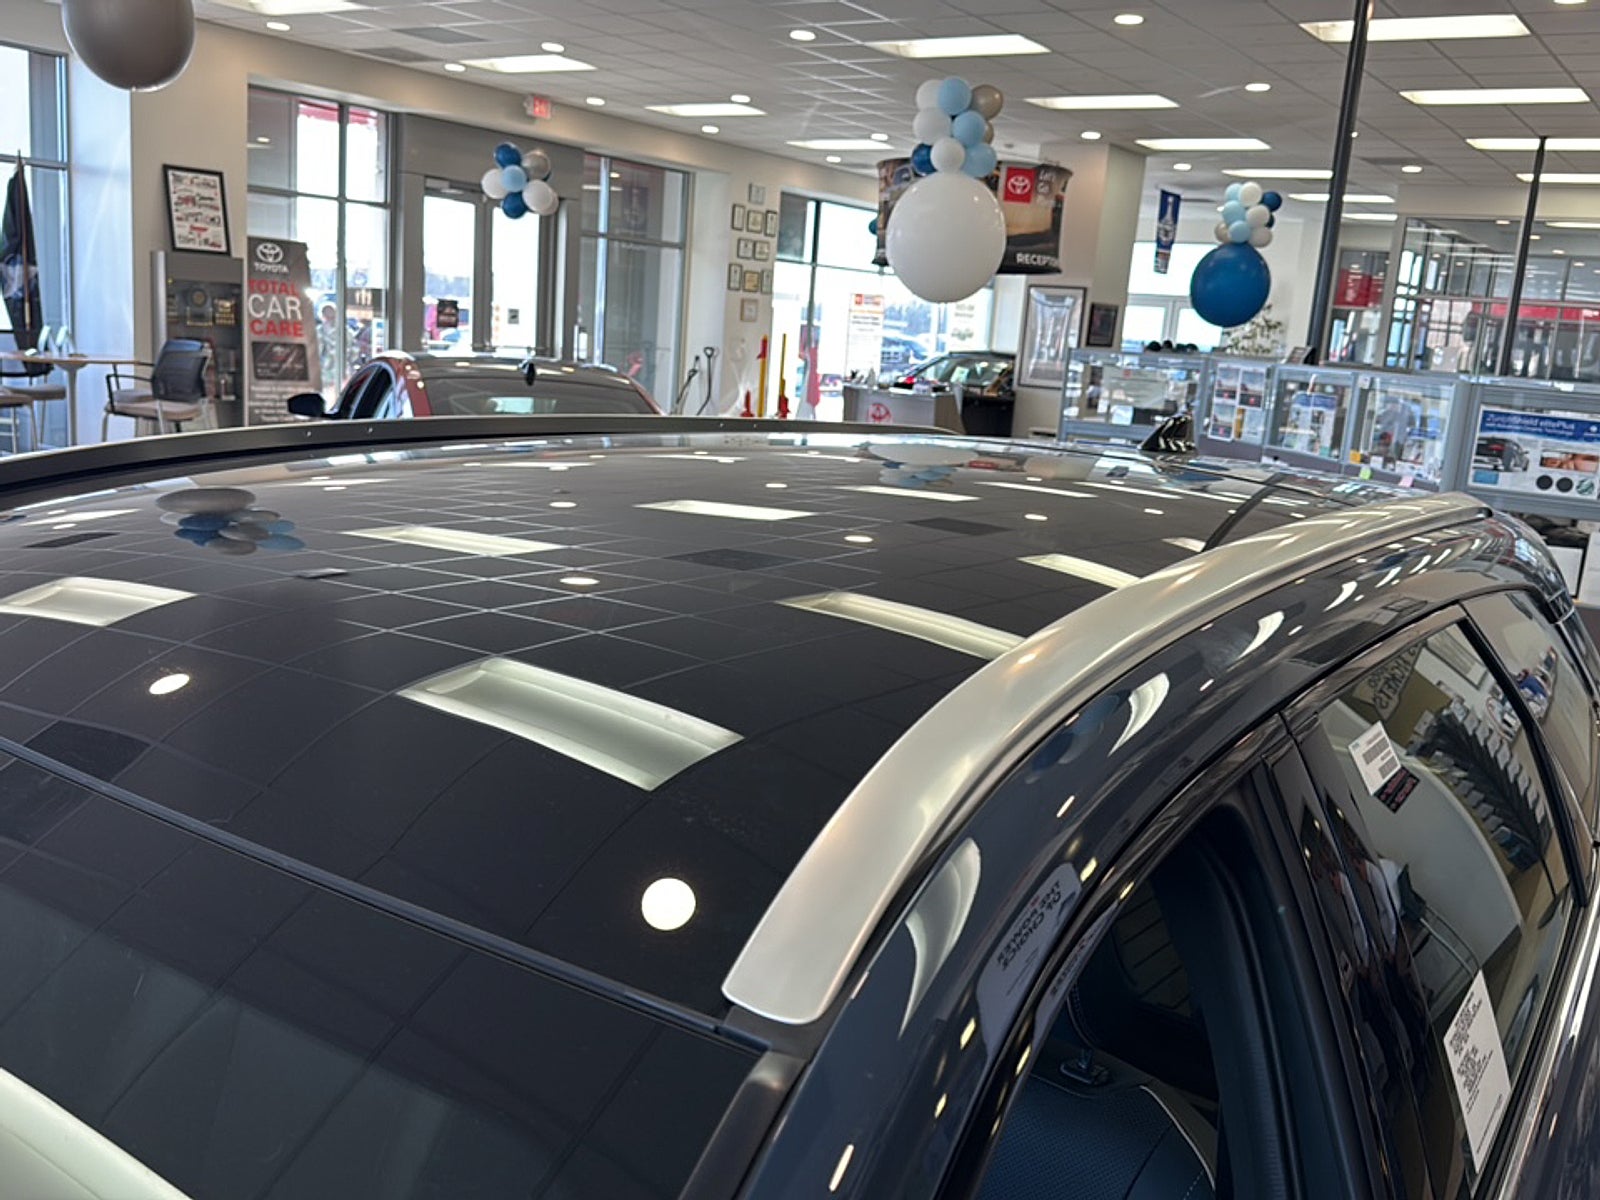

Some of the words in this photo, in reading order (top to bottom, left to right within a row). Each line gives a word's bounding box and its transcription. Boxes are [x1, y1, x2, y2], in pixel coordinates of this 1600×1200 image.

[254, 261, 289, 273] TOYOTA
[248, 279, 300, 299] TOTAL
[248, 293, 303, 320] CAR
[249, 319, 304, 338] CARE
